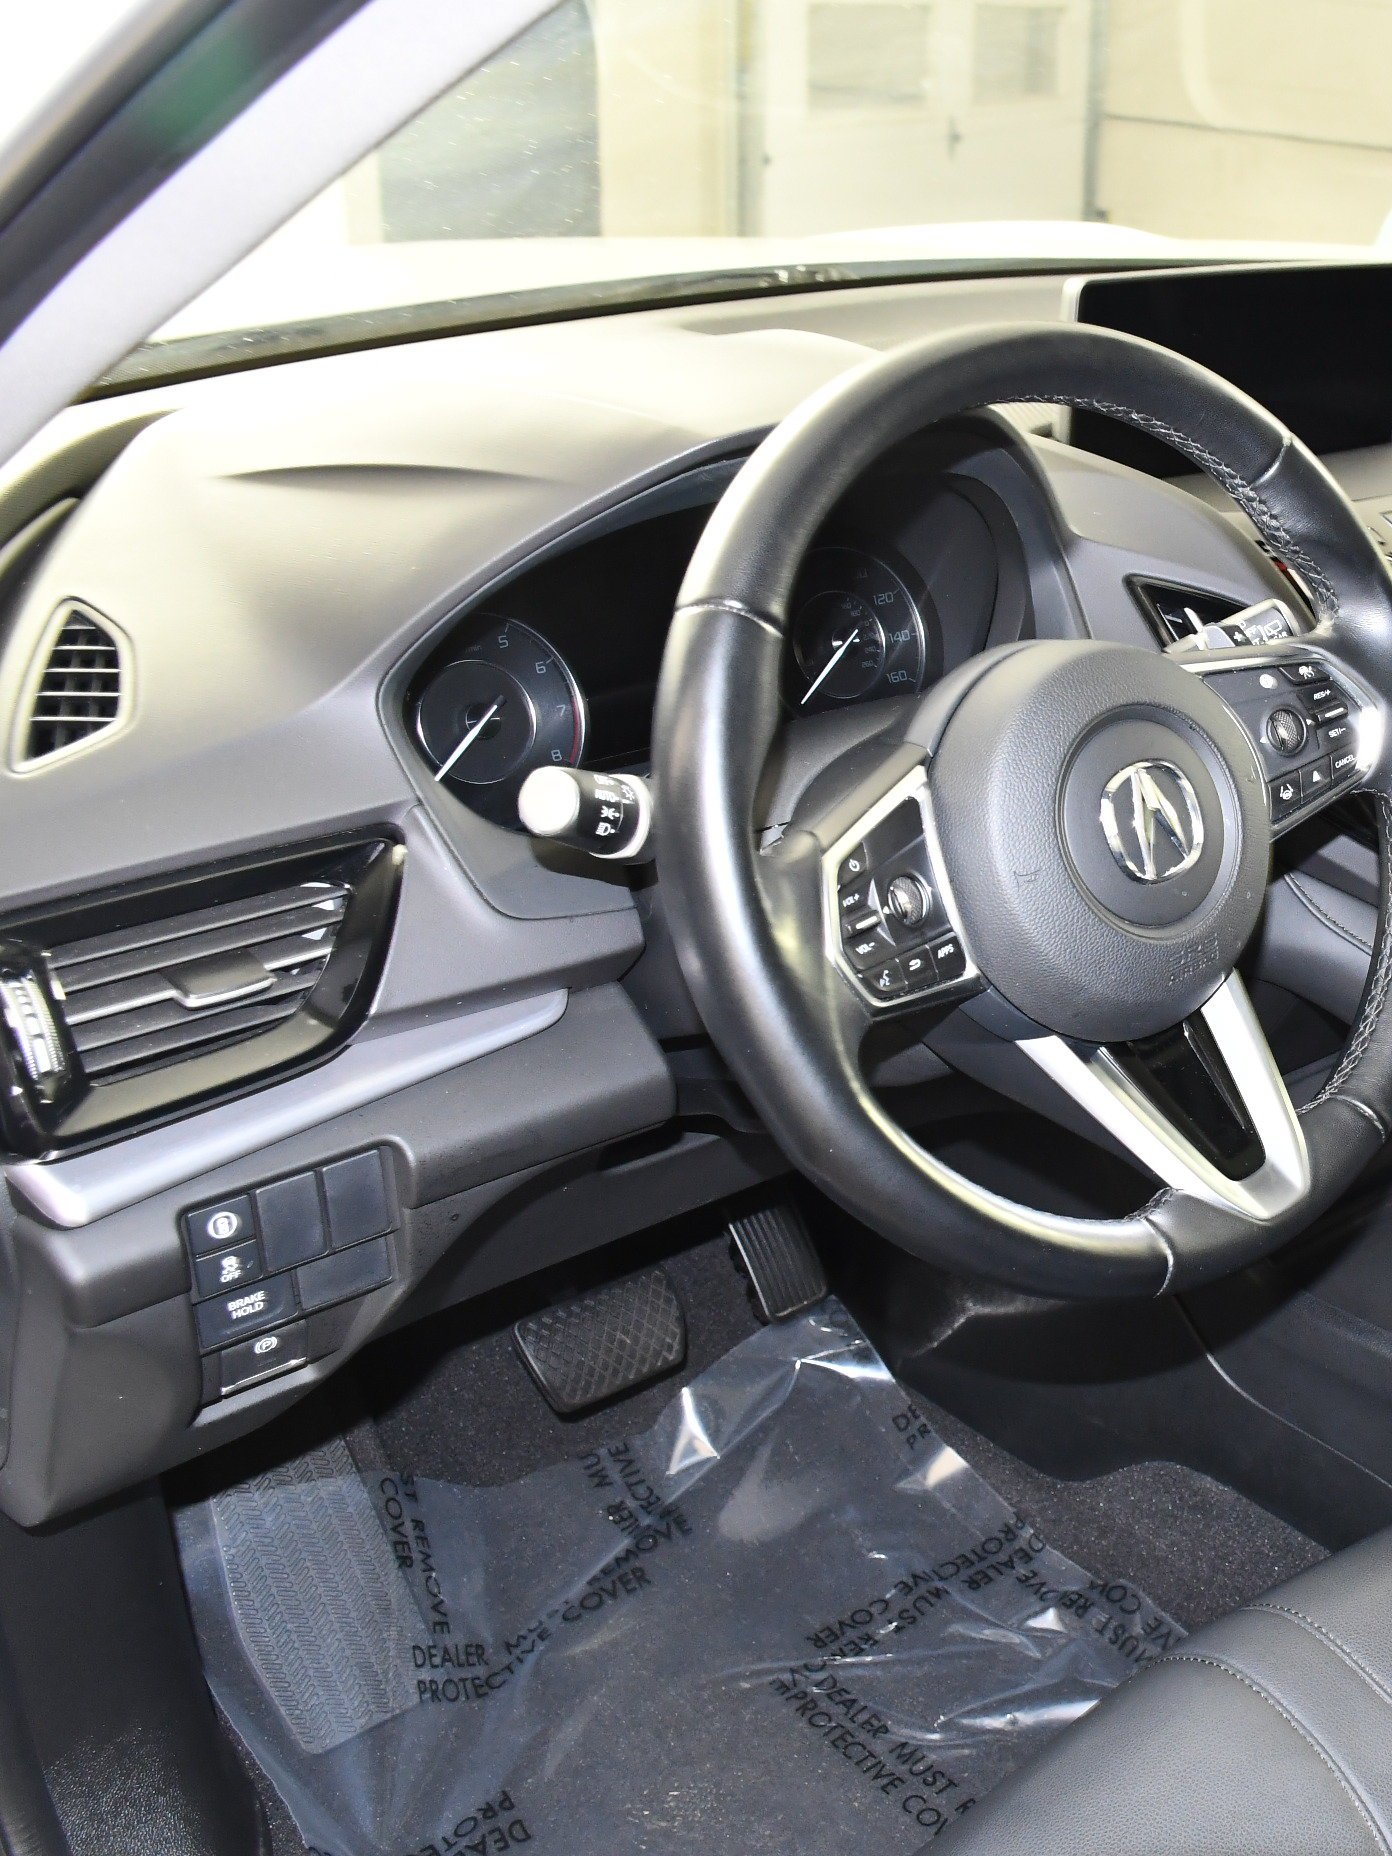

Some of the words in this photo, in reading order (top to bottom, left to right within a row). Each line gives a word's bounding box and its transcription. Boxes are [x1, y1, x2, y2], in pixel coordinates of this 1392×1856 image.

[873, 591, 894, 606] 120
[497, 635, 509, 649] 5
[889, 629, 911, 643] 140
[535, 661, 547, 674] 6
[886, 669, 908, 684] 160
[556, 704, 566, 717] 7
[550, 749, 562, 762] 8
[1335, 754, 1357, 769] CANCEL
[937, 943, 954, 959] APPS
[221, 1270, 241, 1282] OFF
[228, 1291, 265, 1312] BRAKE
[233, 1302, 264, 1319] HOLD
[379, 1477, 414, 1569] COVER
[893, 1511, 1027, 1598] PROTECTIVE
[960, 1532, 1046, 1592] DEALER
[411, 1518, 451, 1634] REMOVE
[804, 1599, 890, 1649] COVER
[416, 1627, 552, 1704] PROTECTIVE
[561, 1566, 652, 1623] COVER
[411, 1643, 490, 1670] DEALER
[785, 1689, 906, 1796] PROTECTIVE
[812, 1673, 890, 1739] DEALER
[888, 1741, 960, 1796] MUST
[452, 1818, 532, 1856] DEA
